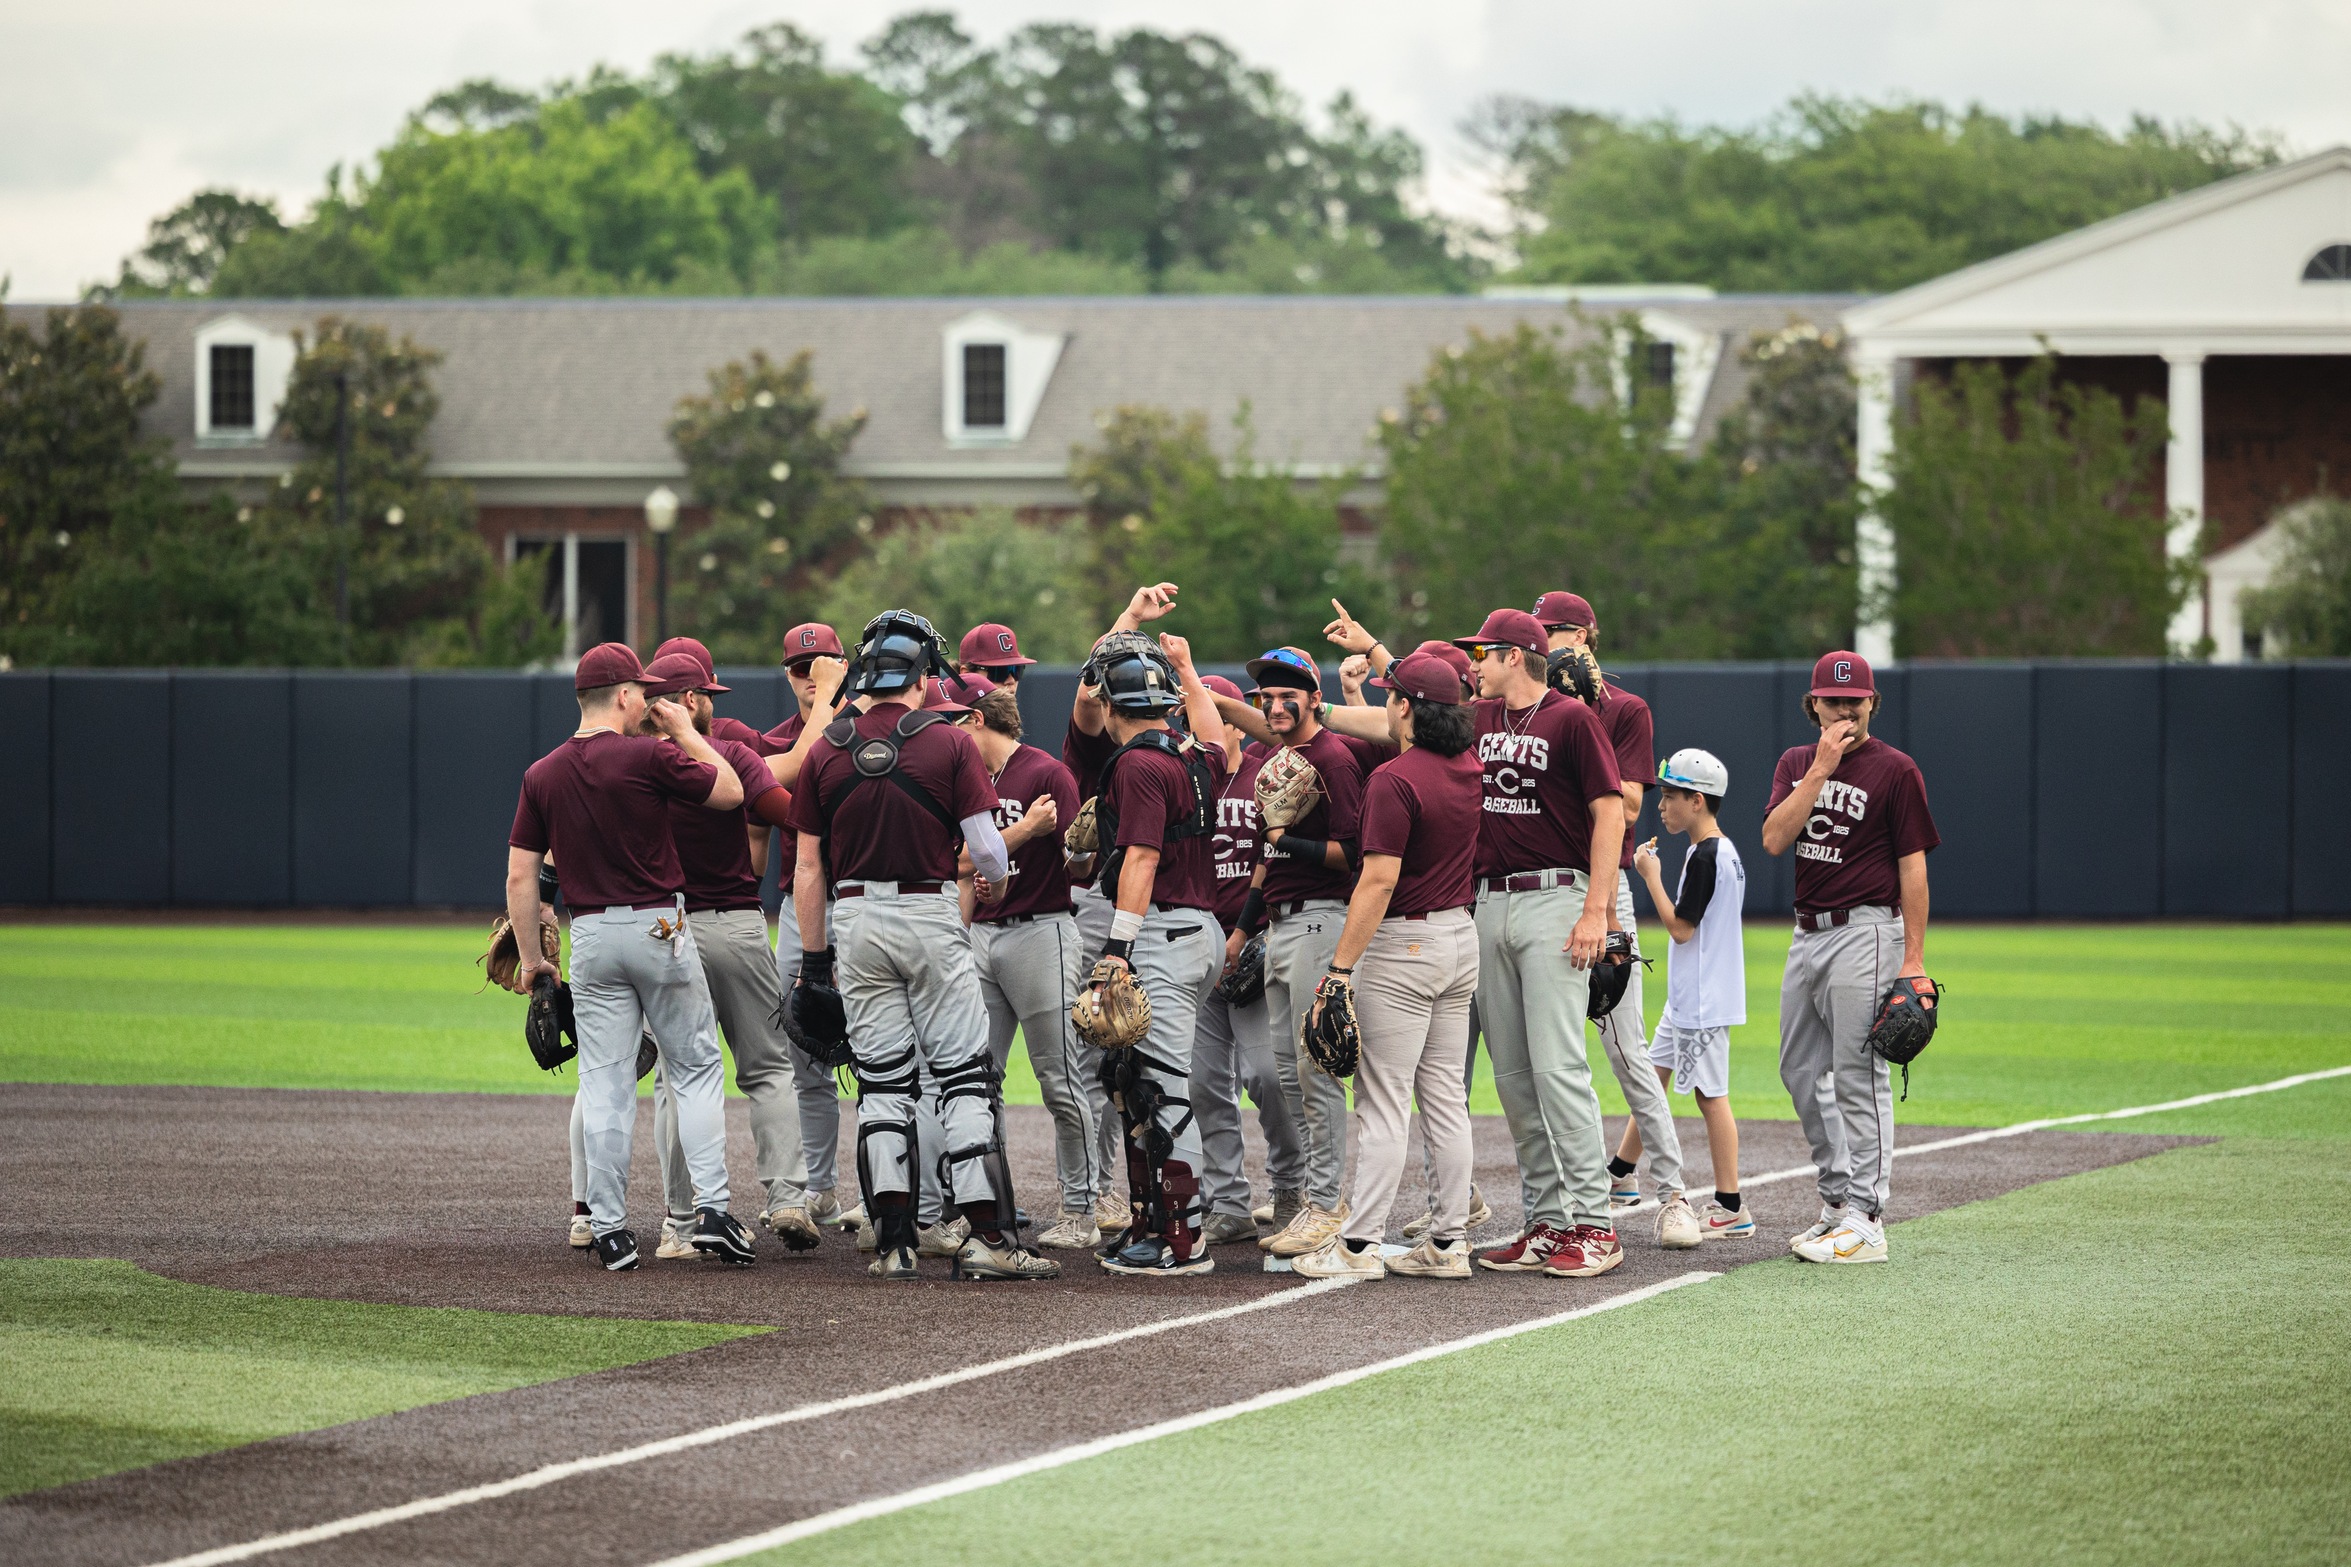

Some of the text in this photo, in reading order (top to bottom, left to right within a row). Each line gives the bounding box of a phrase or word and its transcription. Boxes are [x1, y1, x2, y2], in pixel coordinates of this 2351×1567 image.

[800, 630, 816, 648] C
[997, 633, 1013, 652] C
[1834, 661, 1851, 682] C
[1478, 732, 1549, 771] GENTS
[1494, 767, 1520, 795] C
[1273, 798, 1289, 810] JLM
[1482, 796, 1541, 814] BSEBALL
[1792, 779, 1868, 821] NTS
[1832, 825, 1850, 836] 1825
[1236, 839, 1253, 849] 1825
